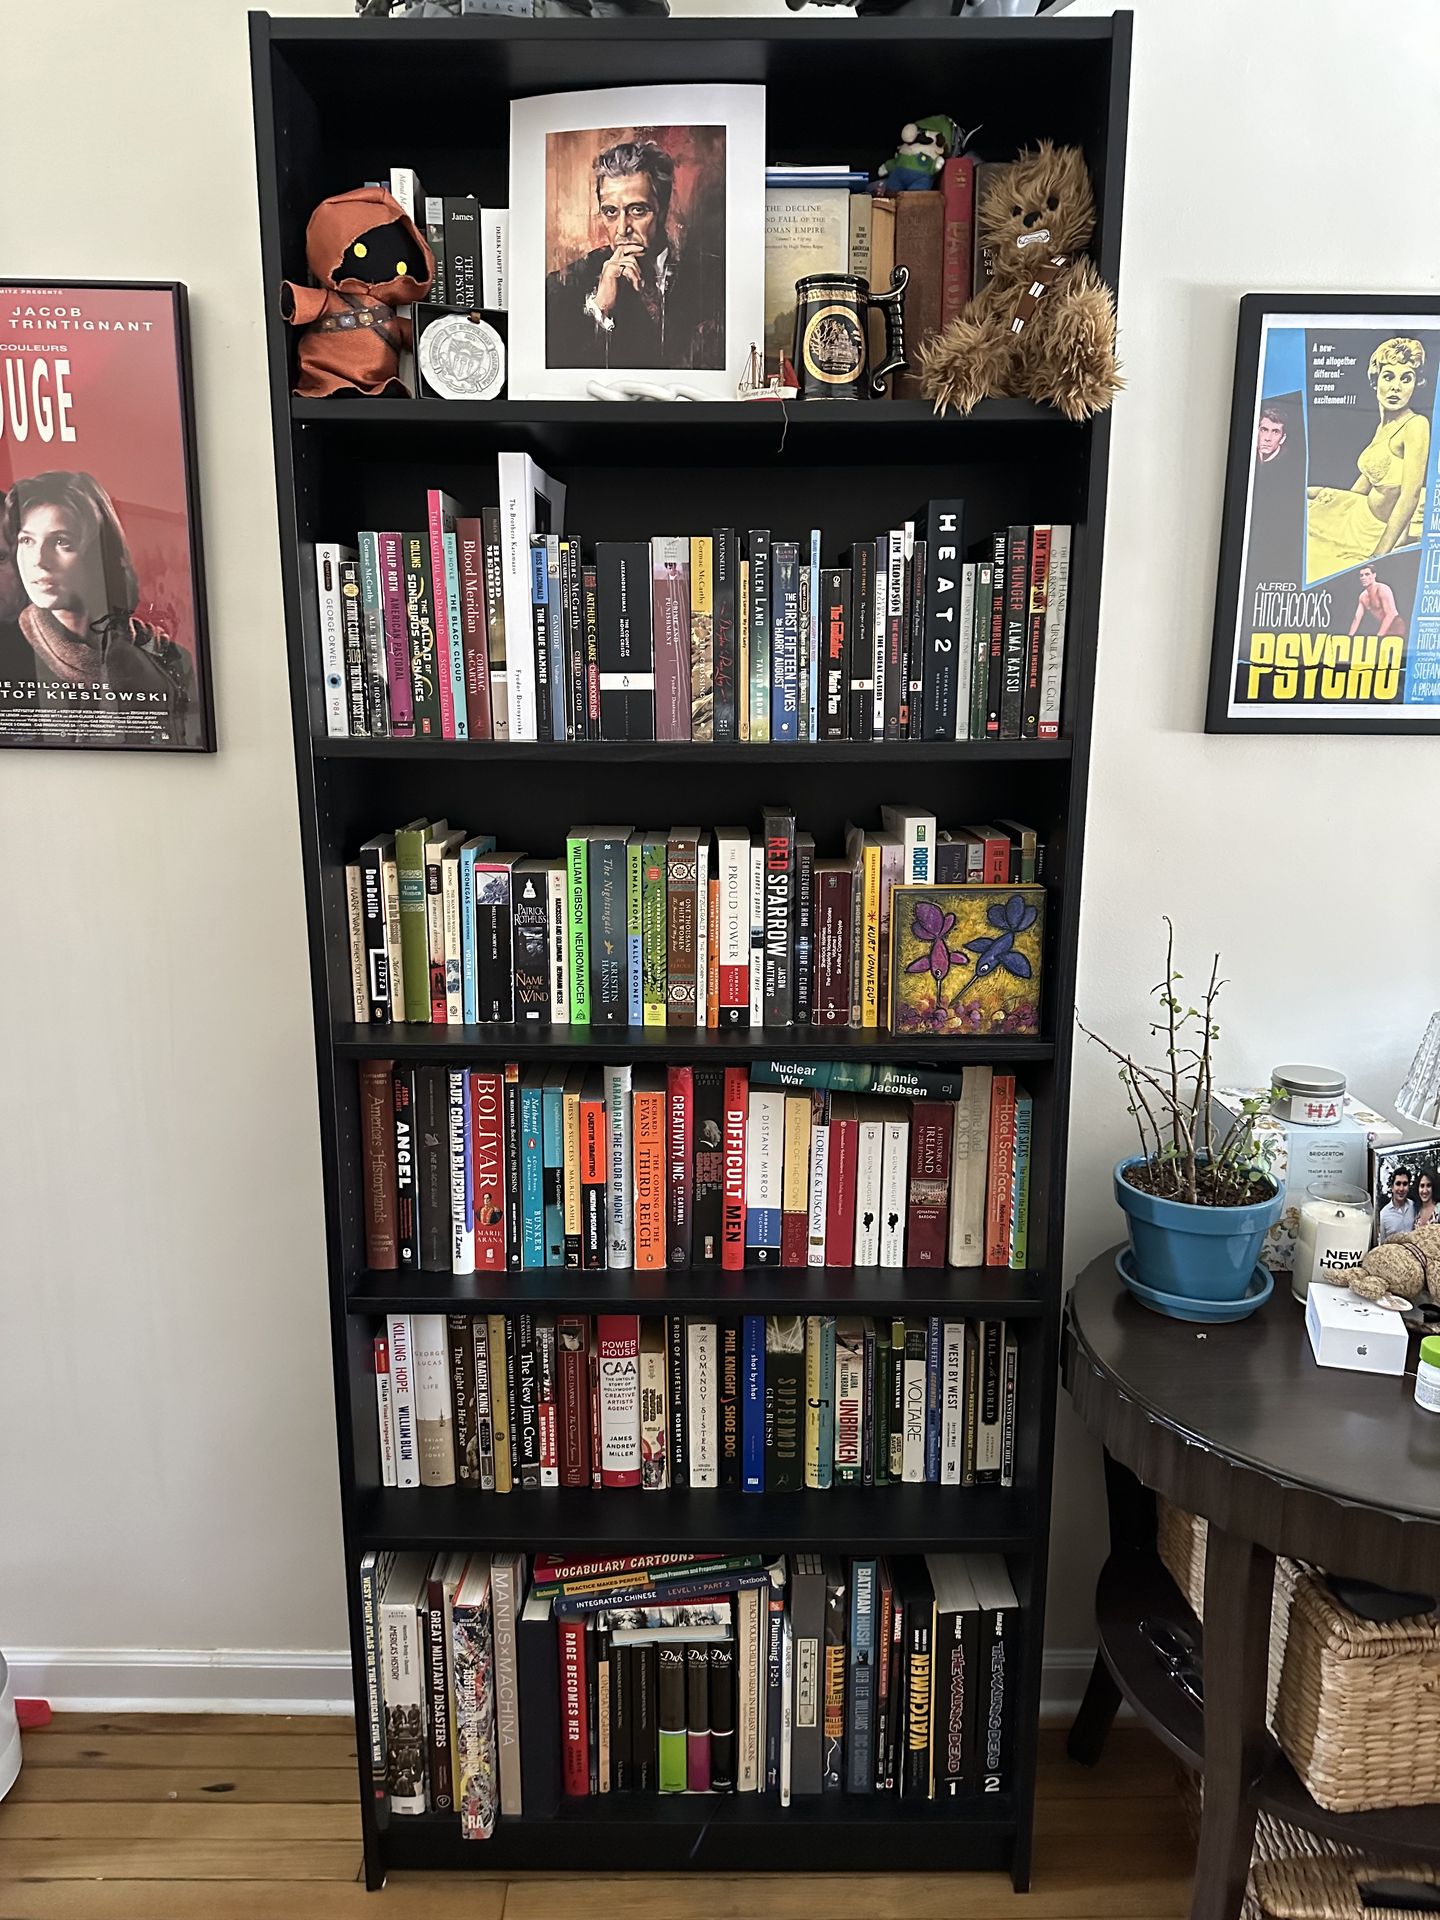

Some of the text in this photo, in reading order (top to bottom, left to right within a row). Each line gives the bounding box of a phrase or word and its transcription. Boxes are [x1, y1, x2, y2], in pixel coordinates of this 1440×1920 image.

[452, 212, 474, 221] James
[9, 320, 153, 332] TRINTIGNANT
[12, 307, 81, 317] JACOB
[0, 343, 67, 352] COULEURS
[1319, 344, 1335, 352] new-
[1326, 357, 1356, 366] altogether
[1314, 370, 1344, 378] different-
[1313, 396, 1355, 404] excitement!!!
[386, 540, 398, 592] PHILIP ROTH
[410, 540, 421, 568] COLLINS
[994, 538, 1005, 589] PHILIP ROTH
[1010, 540, 1025, 610] THE HUNGER
[408, 574, 419, 636] SONGBIRDS
[463, 540, 479, 633] Blood Meridian
[755, 553, 767, 626] FALLEN LAND
[934, 514, 957, 652] HEAT 2
[1256, 583, 1297, 591] ALFRED
[326, 598, 335, 632] GEORGE
[785, 603, 796, 632] FIRST
[992, 596, 1003, 657] THE HUMBLING
[1252, 589, 1331, 628] HITCHCOCK'S
[328, 635, 337, 667] ORWELL
[390, 598, 405, 681] AMERICAN PASTORAL
[421, 617, 431, 660] BALLAD
[774, 627, 784, 688] HARRY AUGUST
[785, 636, 797, 680] FIFTEEN
[1007, 621, 1021, 692] ALMA KATSU
[18, 681, 84, 689] TRILOGIE
[413, 658, 424, 702] SNAKES
[468, 649, 478, 694] McCARTHY
[476, 653, 485, 691] CORMAC
[1247, 633, 1404, 699] PSYCHO
[47, 690, 168, 702] KIESLOWSKI
[332, 697, 340, 716] 1984
[784, 684, 796, 711] LIVES
[828, 670, 841, 714] Mario Puzo
[573, 846, 582, 924] WILLIAM GIBSON
[603, 859, 612, 934] The Nightingale
[767, 837, 788, 957] RED SPARROW
[575, 932, 584, 1004] NEUROMANCER
[602, 960, 610, 1003] HANNAH
[766, 960, 776, 996] MATTHEWS
[777, 967, 786, 988] JASON
[770, 1062, 816, 1076] Nuclear
[780, 1074, 804, 1086] War
[871, 1082, 927, 1096] Jacobsen
[884, 1072, 918, 1085] Annie
[613, 1077, 622, 1129] BARADARAN
[640, 1099, 650, 1136] EVANS
[396, 1121, 411, 1189] ANGEL
[450, 1073, 465, 1221] BLUE COLLAR BLUEPRINT
[477, 1078, 501, 1188] BOLÍVAR
[671, 1096, 684, 1183] CREATIVITY, INC.
[925, 1126, 935, 1173] IRELAND
[613, 1132, 623, 1224] THE COLOR OF MONEY
[640, 1149, 651, 1248] THIRD REICH
[726, 1110, 743, 1242] DIFFICULT MEN
[1326, 1249, 1362, 1260] NEW
[393, 1322, 408, 1393] KILLING HOPE
[602, 1340, 636, 1348] POWER
[725, 1330, 736, 1395] PHIL KNIGHT
[454, 1347, 467, 1446] The Light On Her Face
[477, 1341, 488, 1414] THE MATCH KING
[766, 1388, 774, 1408] GUS
[948, 1343, 959, 1410] WEST BY WEST
[521, 1352, 535, 1457] The New Jim Crow
[907, 1379, 923, 1442] VOLTAIRE
[398, 1406, 412, 1460] WILLIAM BLUM
[839, 1399, 859, 1464] UNBROKEN
[576, 1591, 657, 1608] INTEGRATED CHINESE
[856, 1568, 871, 1645] BATMAN HUSH
[430, 1610, 448, 1748] GREAT MILITARY DISASTERS
[565, 1633, 580, 1740] RAGE BECOMES HER
[909, 1654, 930, 1750] WATCHMEN
